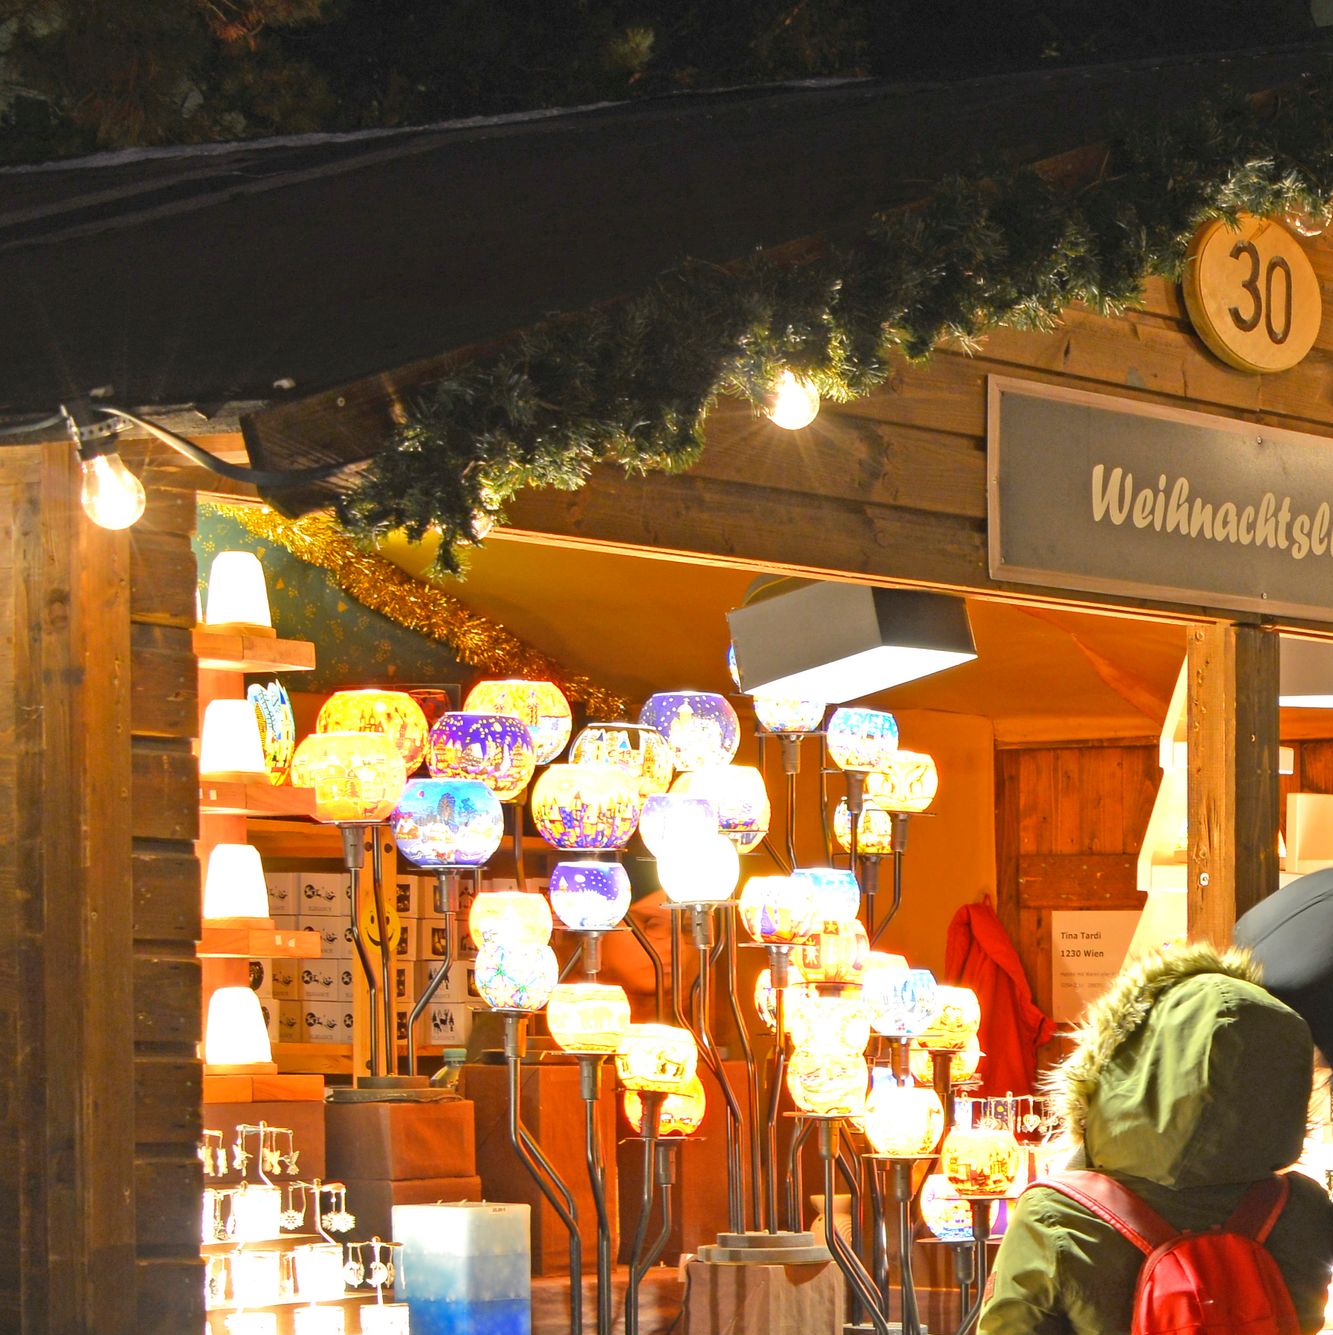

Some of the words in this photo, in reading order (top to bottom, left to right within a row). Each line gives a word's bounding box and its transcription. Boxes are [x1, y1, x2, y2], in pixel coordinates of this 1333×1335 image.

[1227, 239, 1293, 345] 30
[1061, 931, 1078, 940] Tina
[1080, 931, 1102, 940] Tardi
[1061, 949, 1081, 958] 1230
[1083, 949, 1104, 958] Wien
